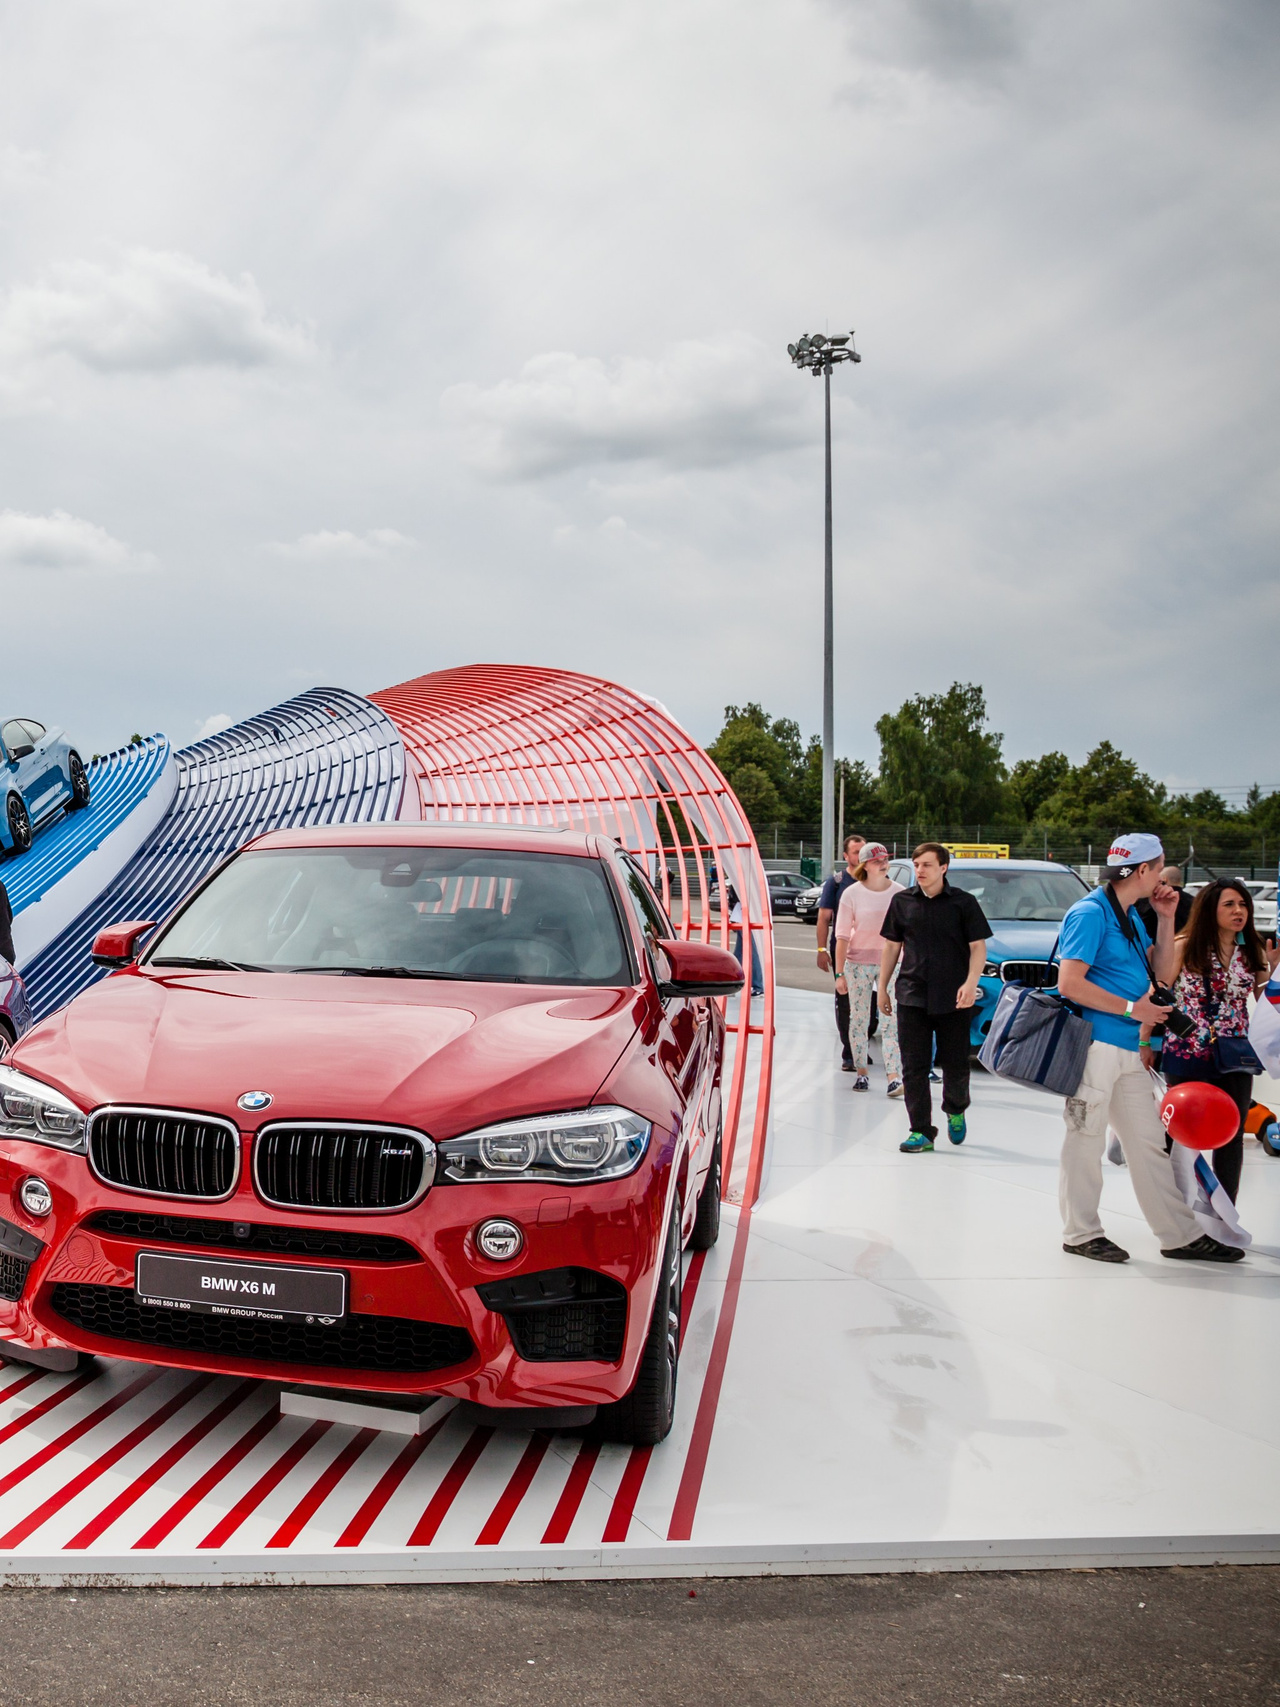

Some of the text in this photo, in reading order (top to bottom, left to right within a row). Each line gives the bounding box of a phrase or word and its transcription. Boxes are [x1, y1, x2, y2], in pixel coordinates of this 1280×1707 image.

[200, 1275, 277, 1296] BMW X6 M
[211, 1306, 284, 1320] BMW GROUP Россия
